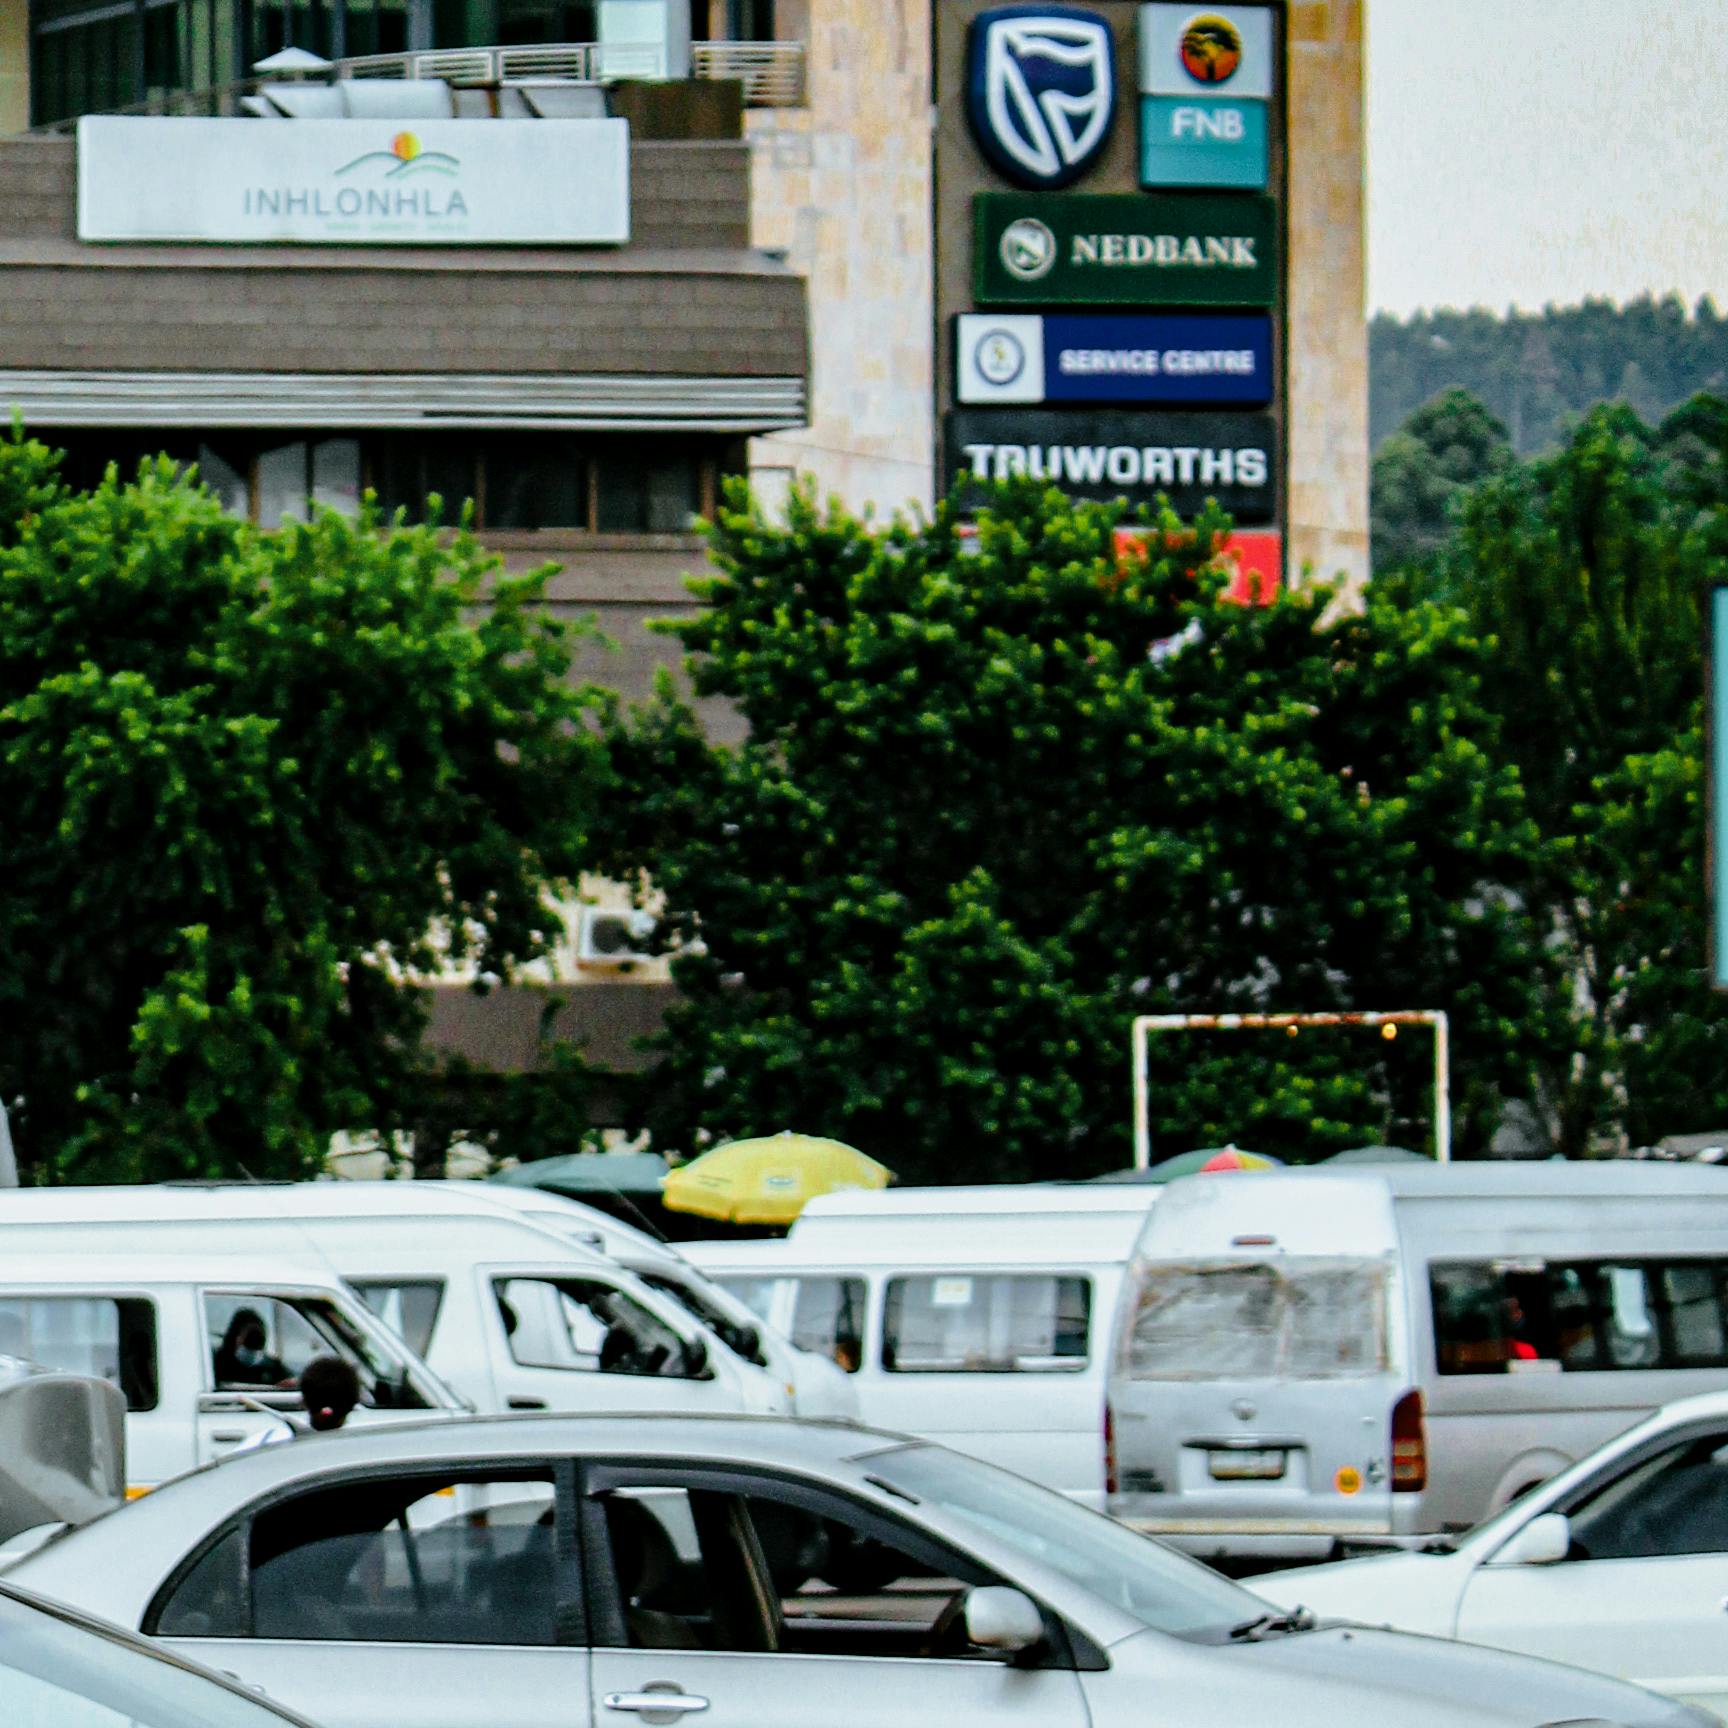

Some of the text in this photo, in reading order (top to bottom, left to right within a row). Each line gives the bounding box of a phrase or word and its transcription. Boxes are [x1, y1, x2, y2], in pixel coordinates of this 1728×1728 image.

[1172, 106, 1244, 140] FNB
[244, 186, 469, 217] INHLONHLA
[1071, 234, 1258, 268] NEDBANK
[1058, 348, 1255, 376] SERVICE CENTRE
[962, 443, 1269, 487] TRUWORTHS
